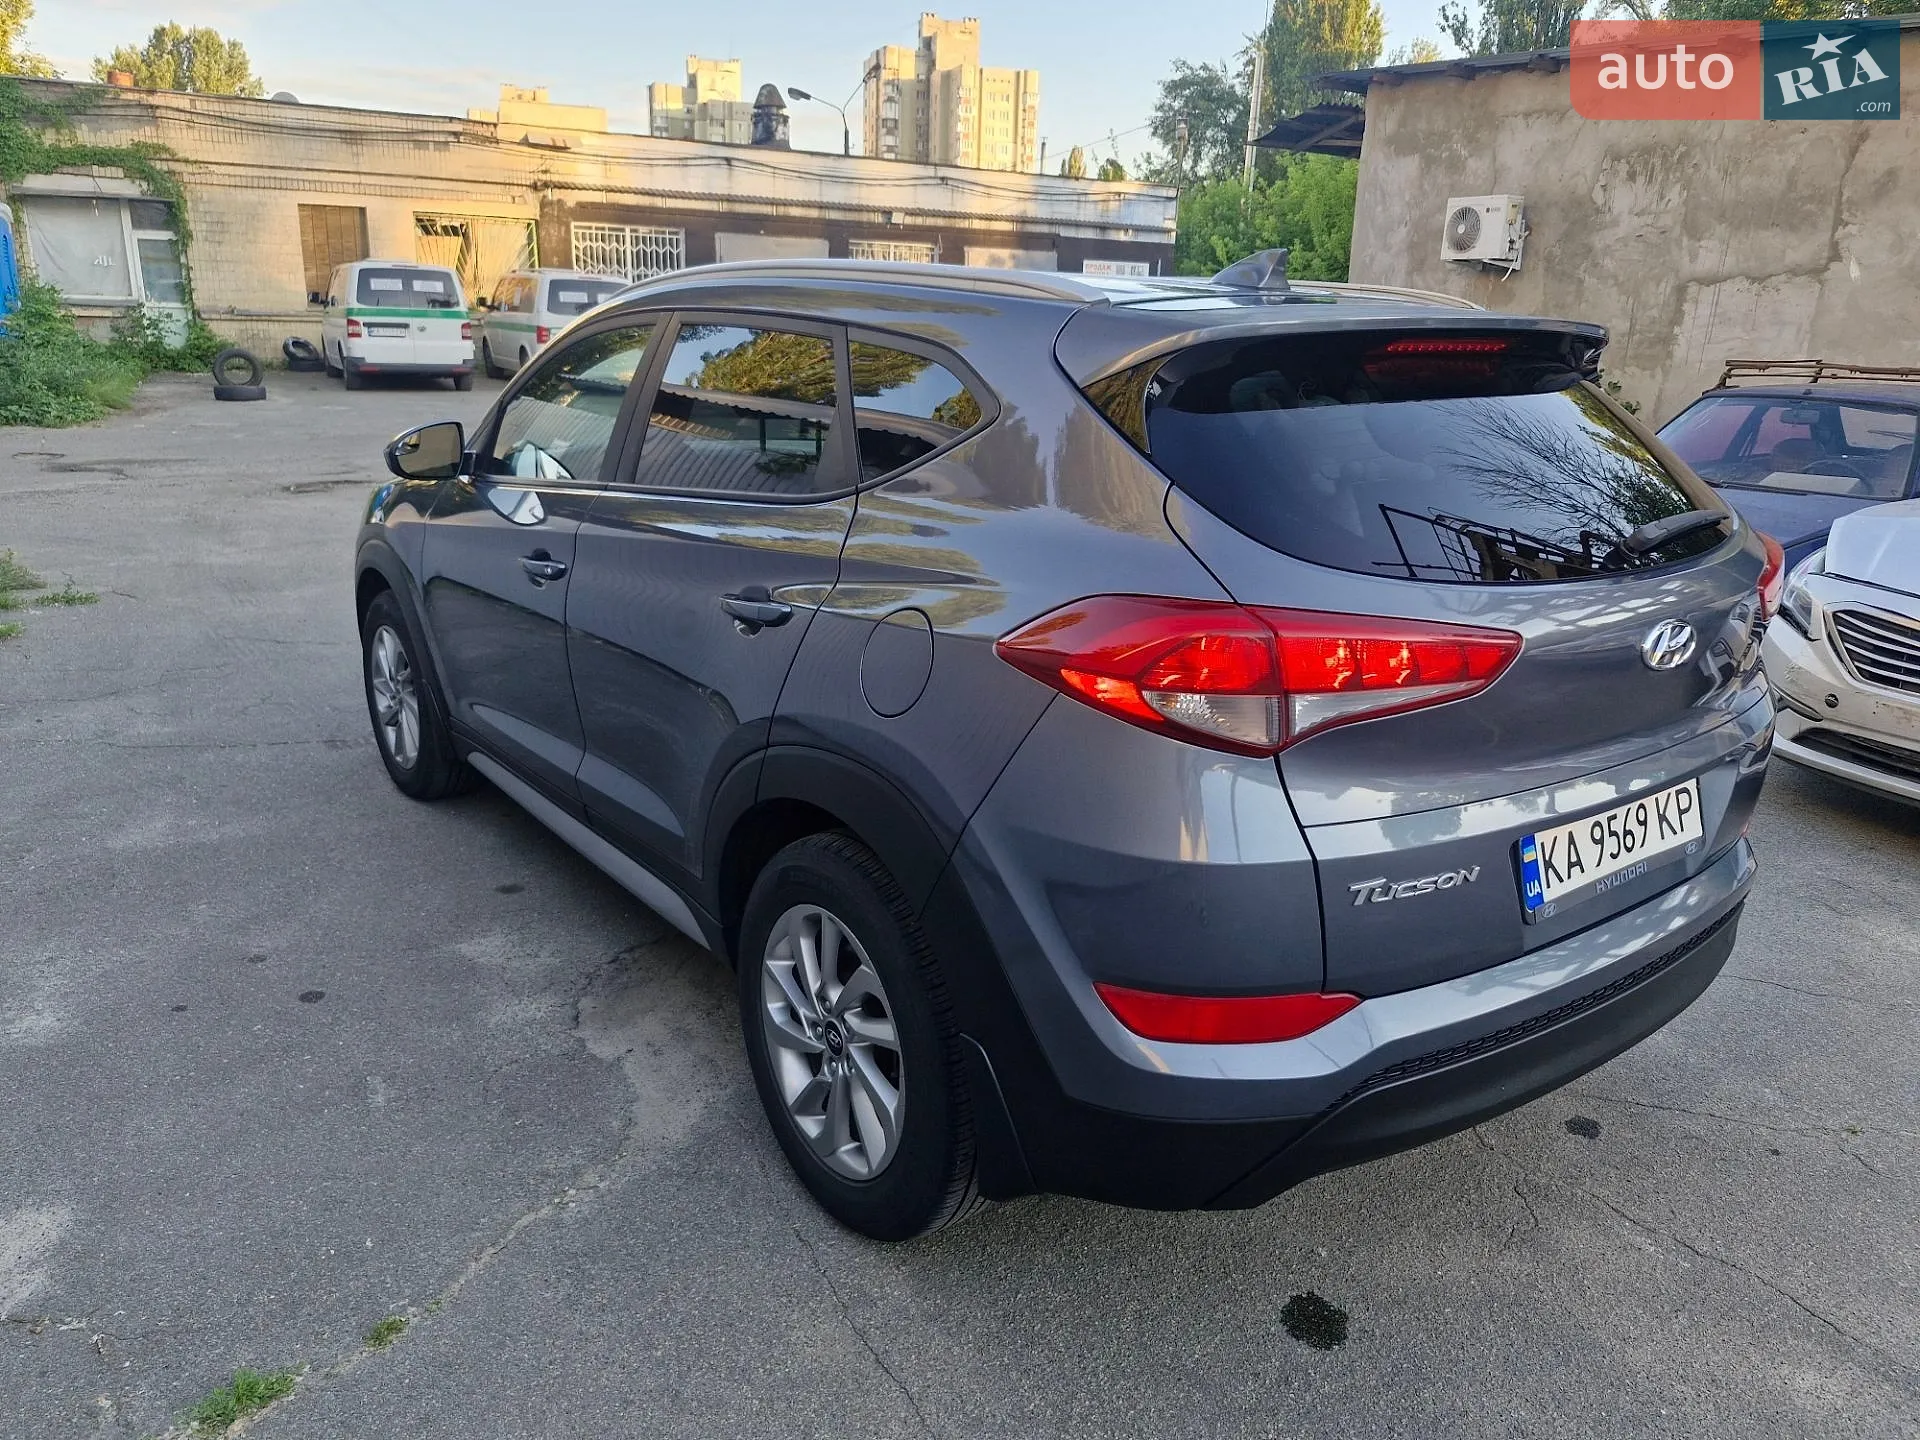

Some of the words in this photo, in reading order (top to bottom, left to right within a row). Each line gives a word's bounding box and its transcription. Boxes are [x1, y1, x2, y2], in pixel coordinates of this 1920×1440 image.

[1540, 829, 1585, 889] KA
[1590, 803, 1648, 868] 9569
[1655, 787, 1693, 840] KP
[1348, 864, 1481, 906] TUCSON
[1526, 879, 1541, 898] UA
[1596, 861, 1648, 894] HYUNDAI
